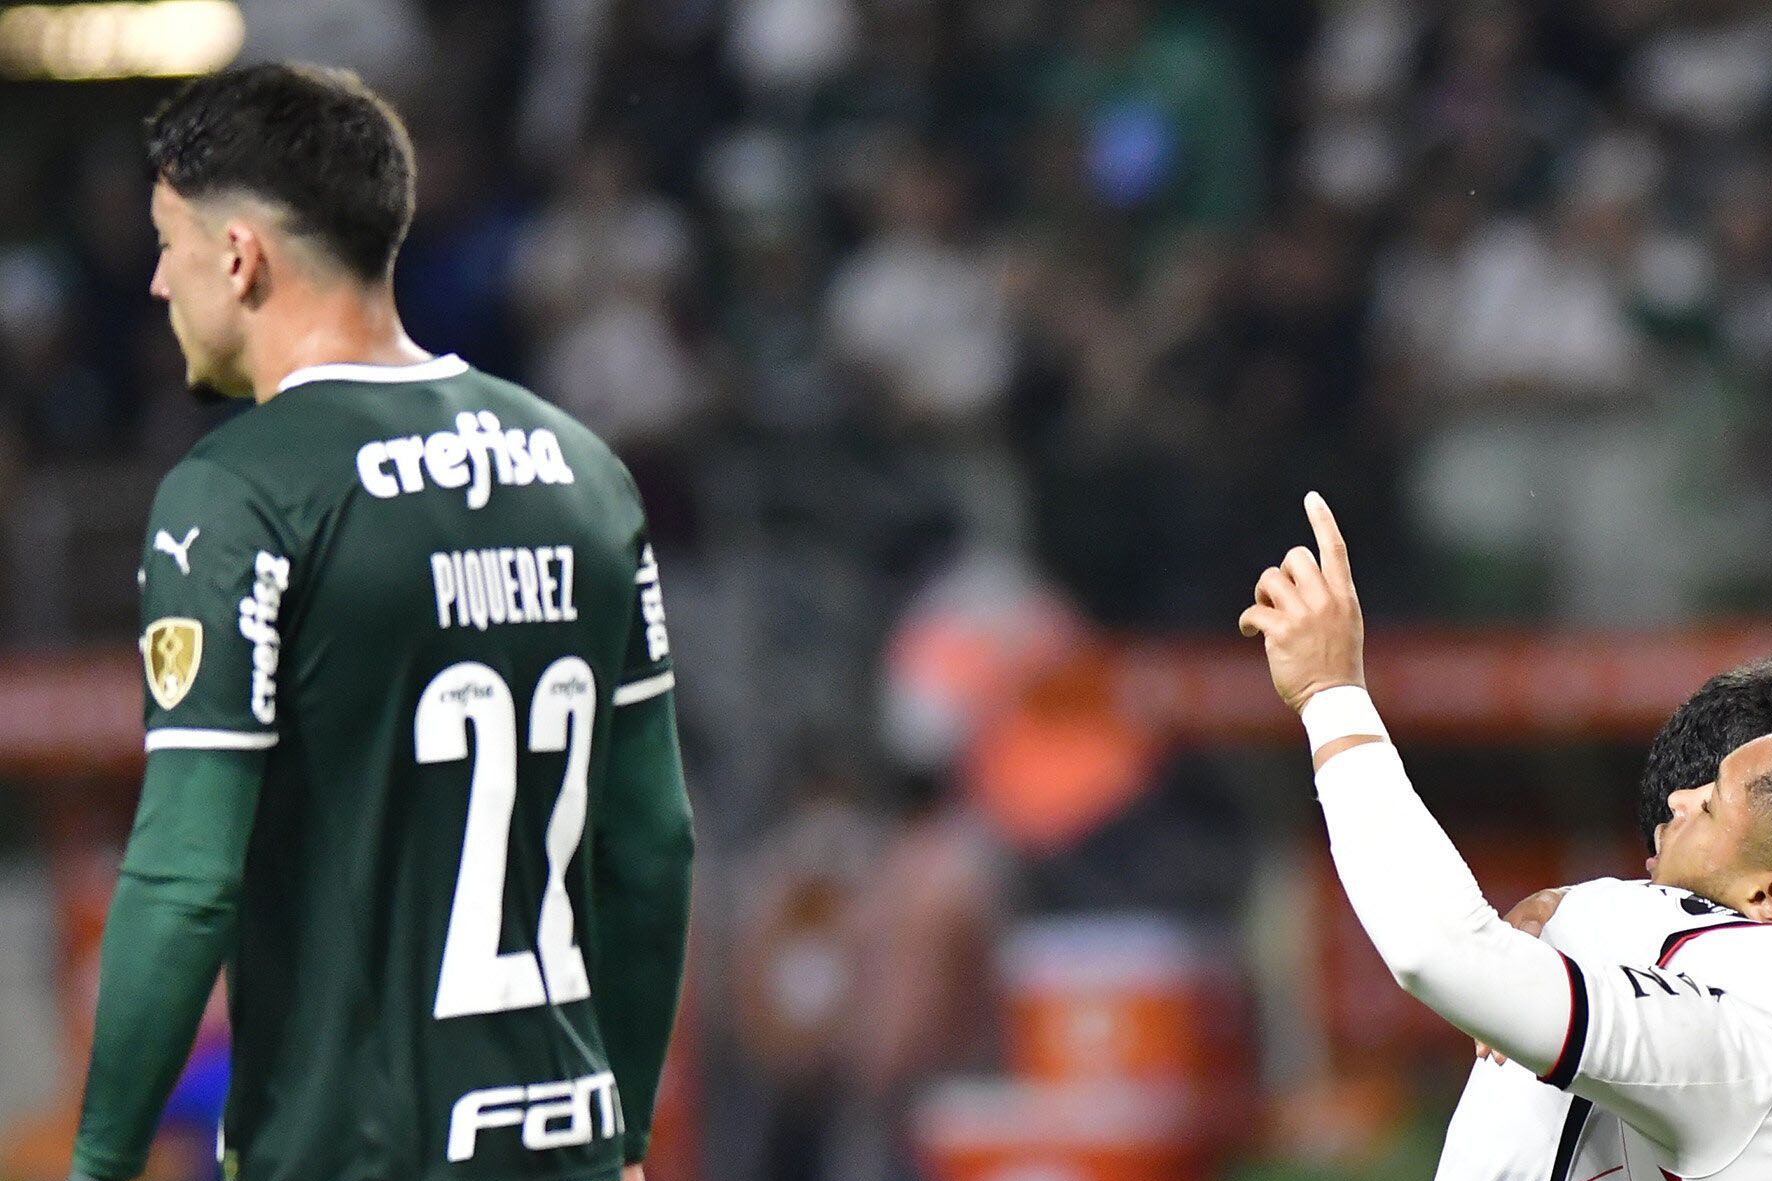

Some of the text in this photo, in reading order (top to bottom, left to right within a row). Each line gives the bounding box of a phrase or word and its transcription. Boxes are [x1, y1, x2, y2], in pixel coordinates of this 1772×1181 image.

[356, 410, 575, 510] crefisa
[238, 549, 291, 725] crefisa
[430, 545, 578, 632] PIQUEREZ
[414, 655, 598, 1020] 22
